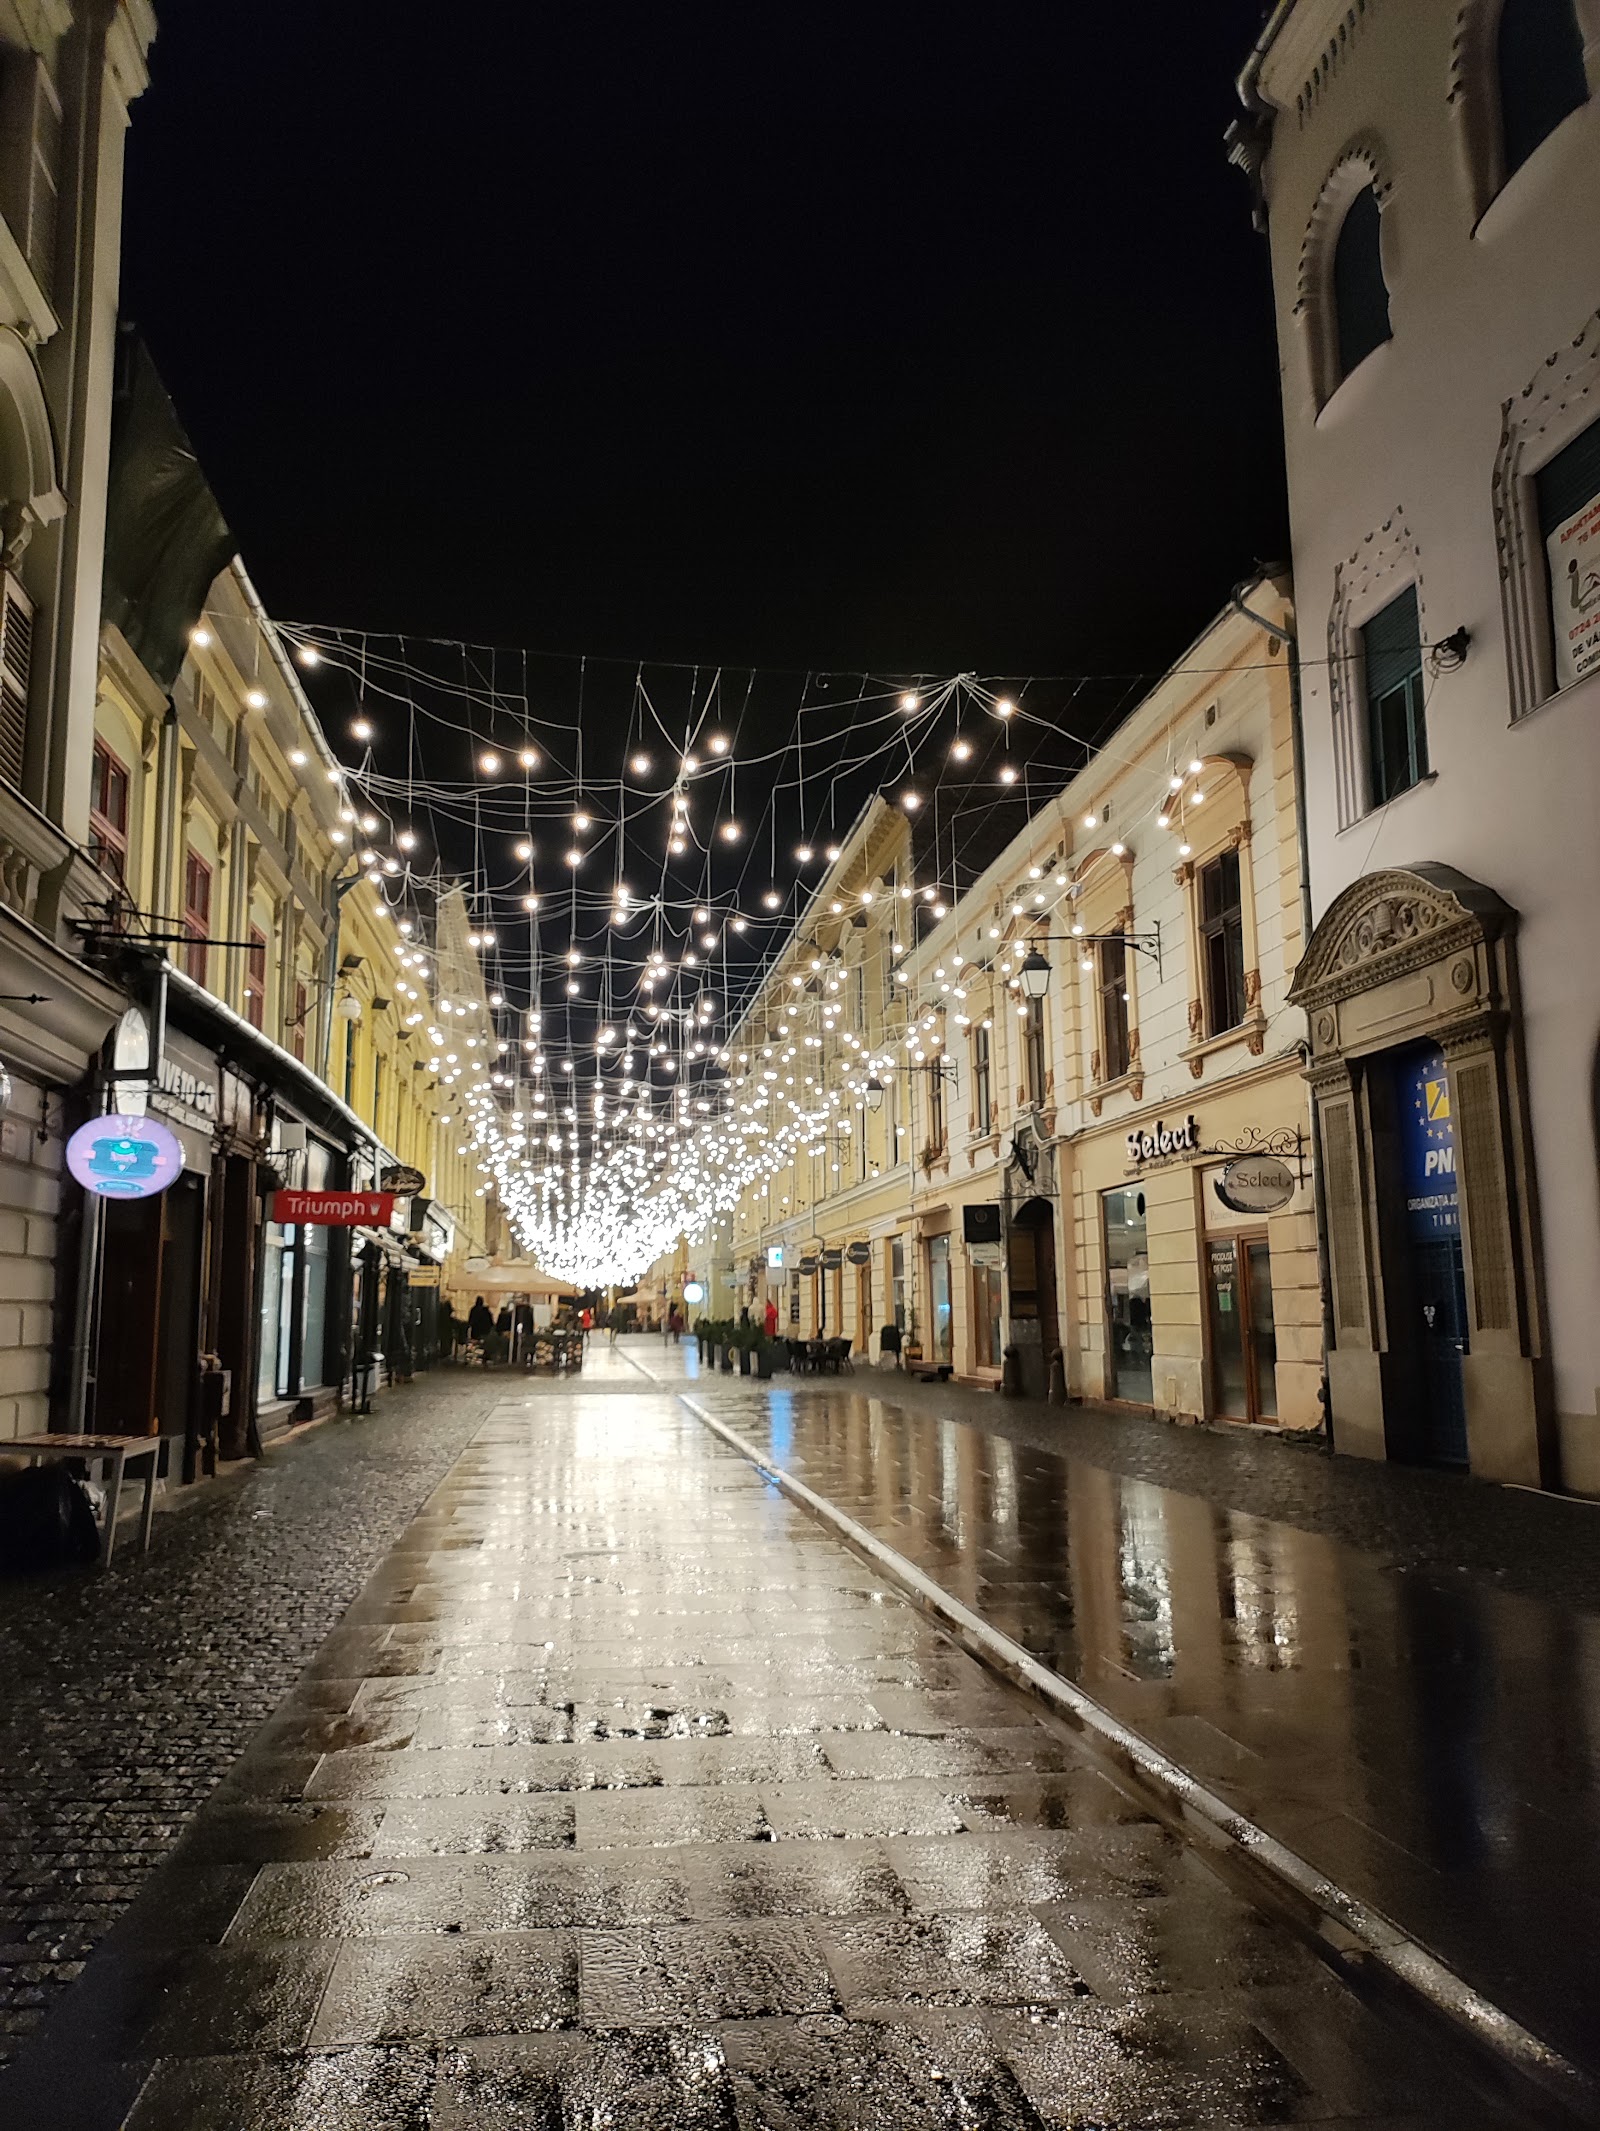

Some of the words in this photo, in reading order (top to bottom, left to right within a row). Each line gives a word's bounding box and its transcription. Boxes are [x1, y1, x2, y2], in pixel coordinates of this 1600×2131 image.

[1572, 643, 1584, 658] DE
[1125, 1115, 1198, 1162] Select
[1236, 1170, 1284, 1188] Select
[288, 1197, 365, 1219] Triumph
[1211, 1251, 1233, 1262] PRODUSE
